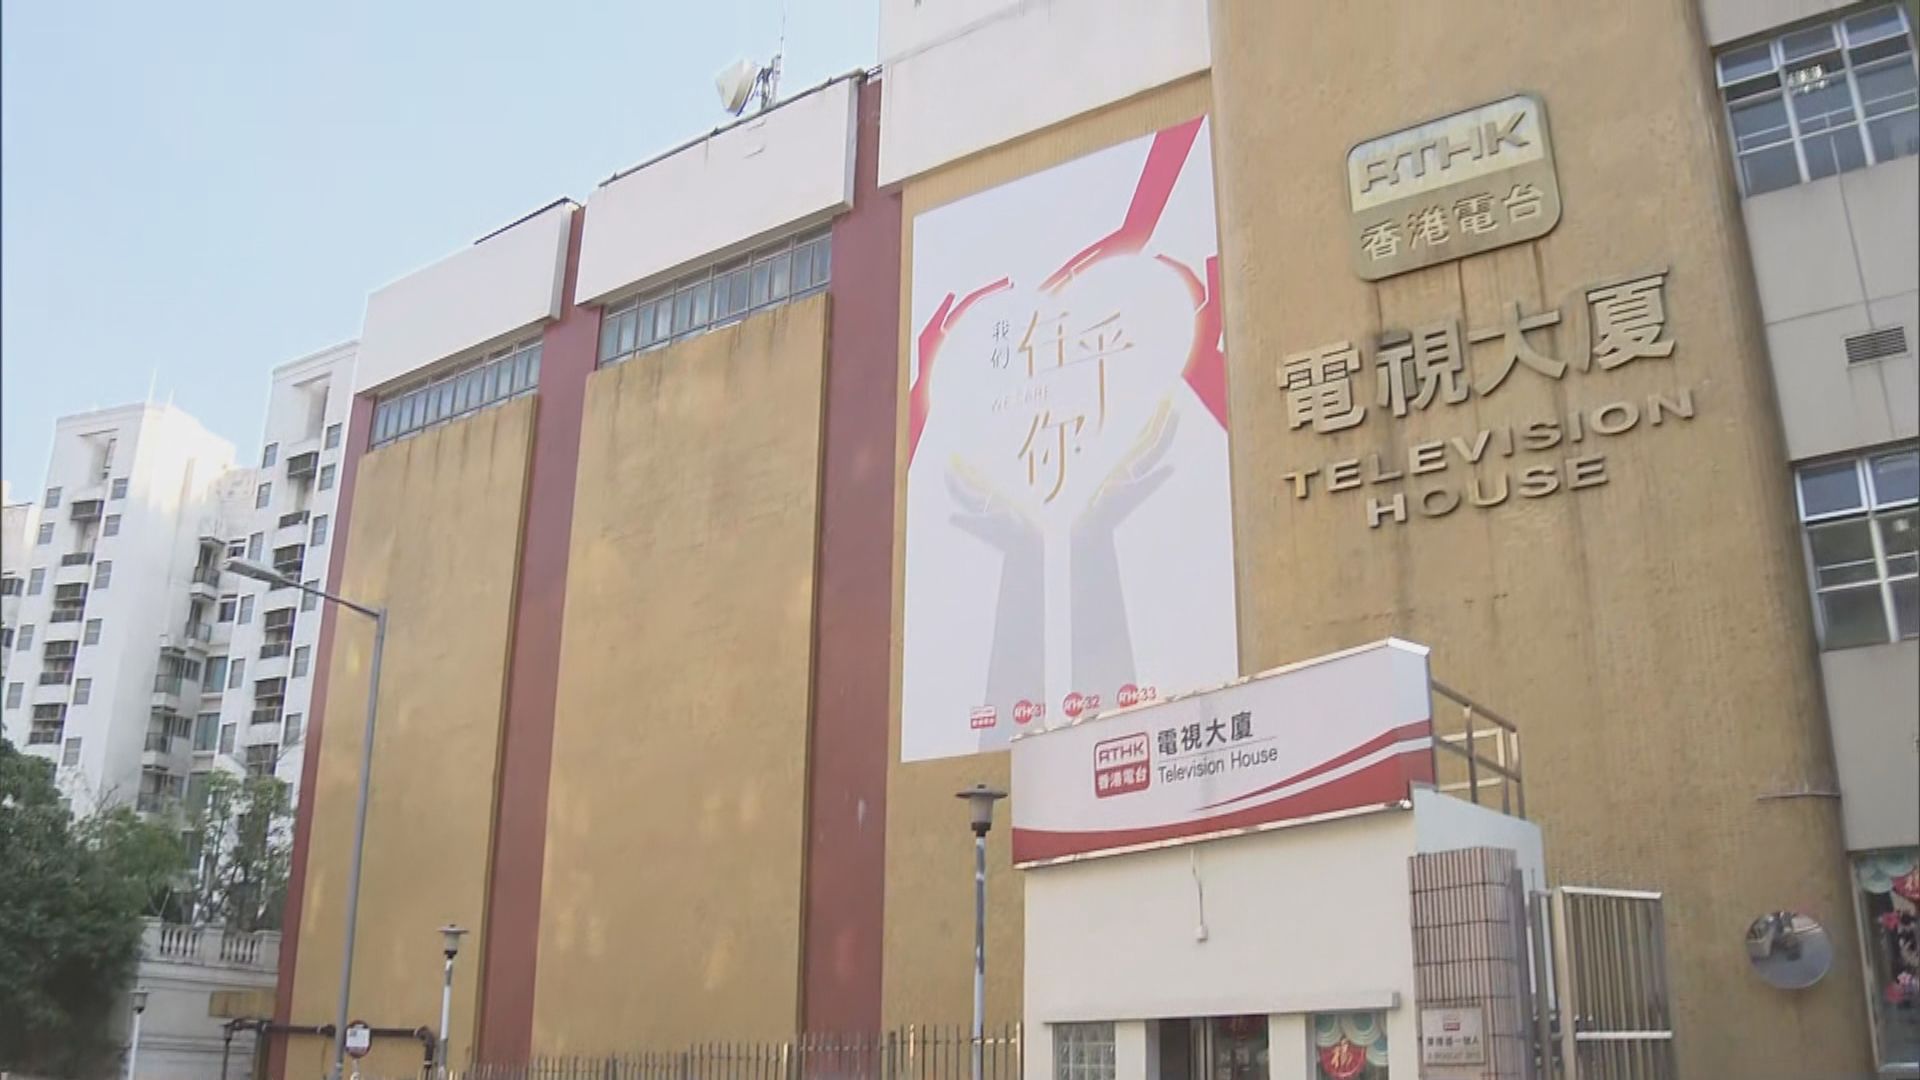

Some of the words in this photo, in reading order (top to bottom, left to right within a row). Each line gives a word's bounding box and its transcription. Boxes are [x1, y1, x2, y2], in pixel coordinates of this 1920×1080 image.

[1360, 110, 1531, 194] RTHK
[1361, 183, 1545, 259] 香港電台
[1284, 388, 1697, 498] TELEVISION
[1367, 455, 1610, 528] HOUSE
[1097, 766, 1147, 791] 香港電台
[1098, 741, 1144, 764] RTHK
[1157, 756, 1225, 785] Television
[1231, 746, 1279, 770] House
